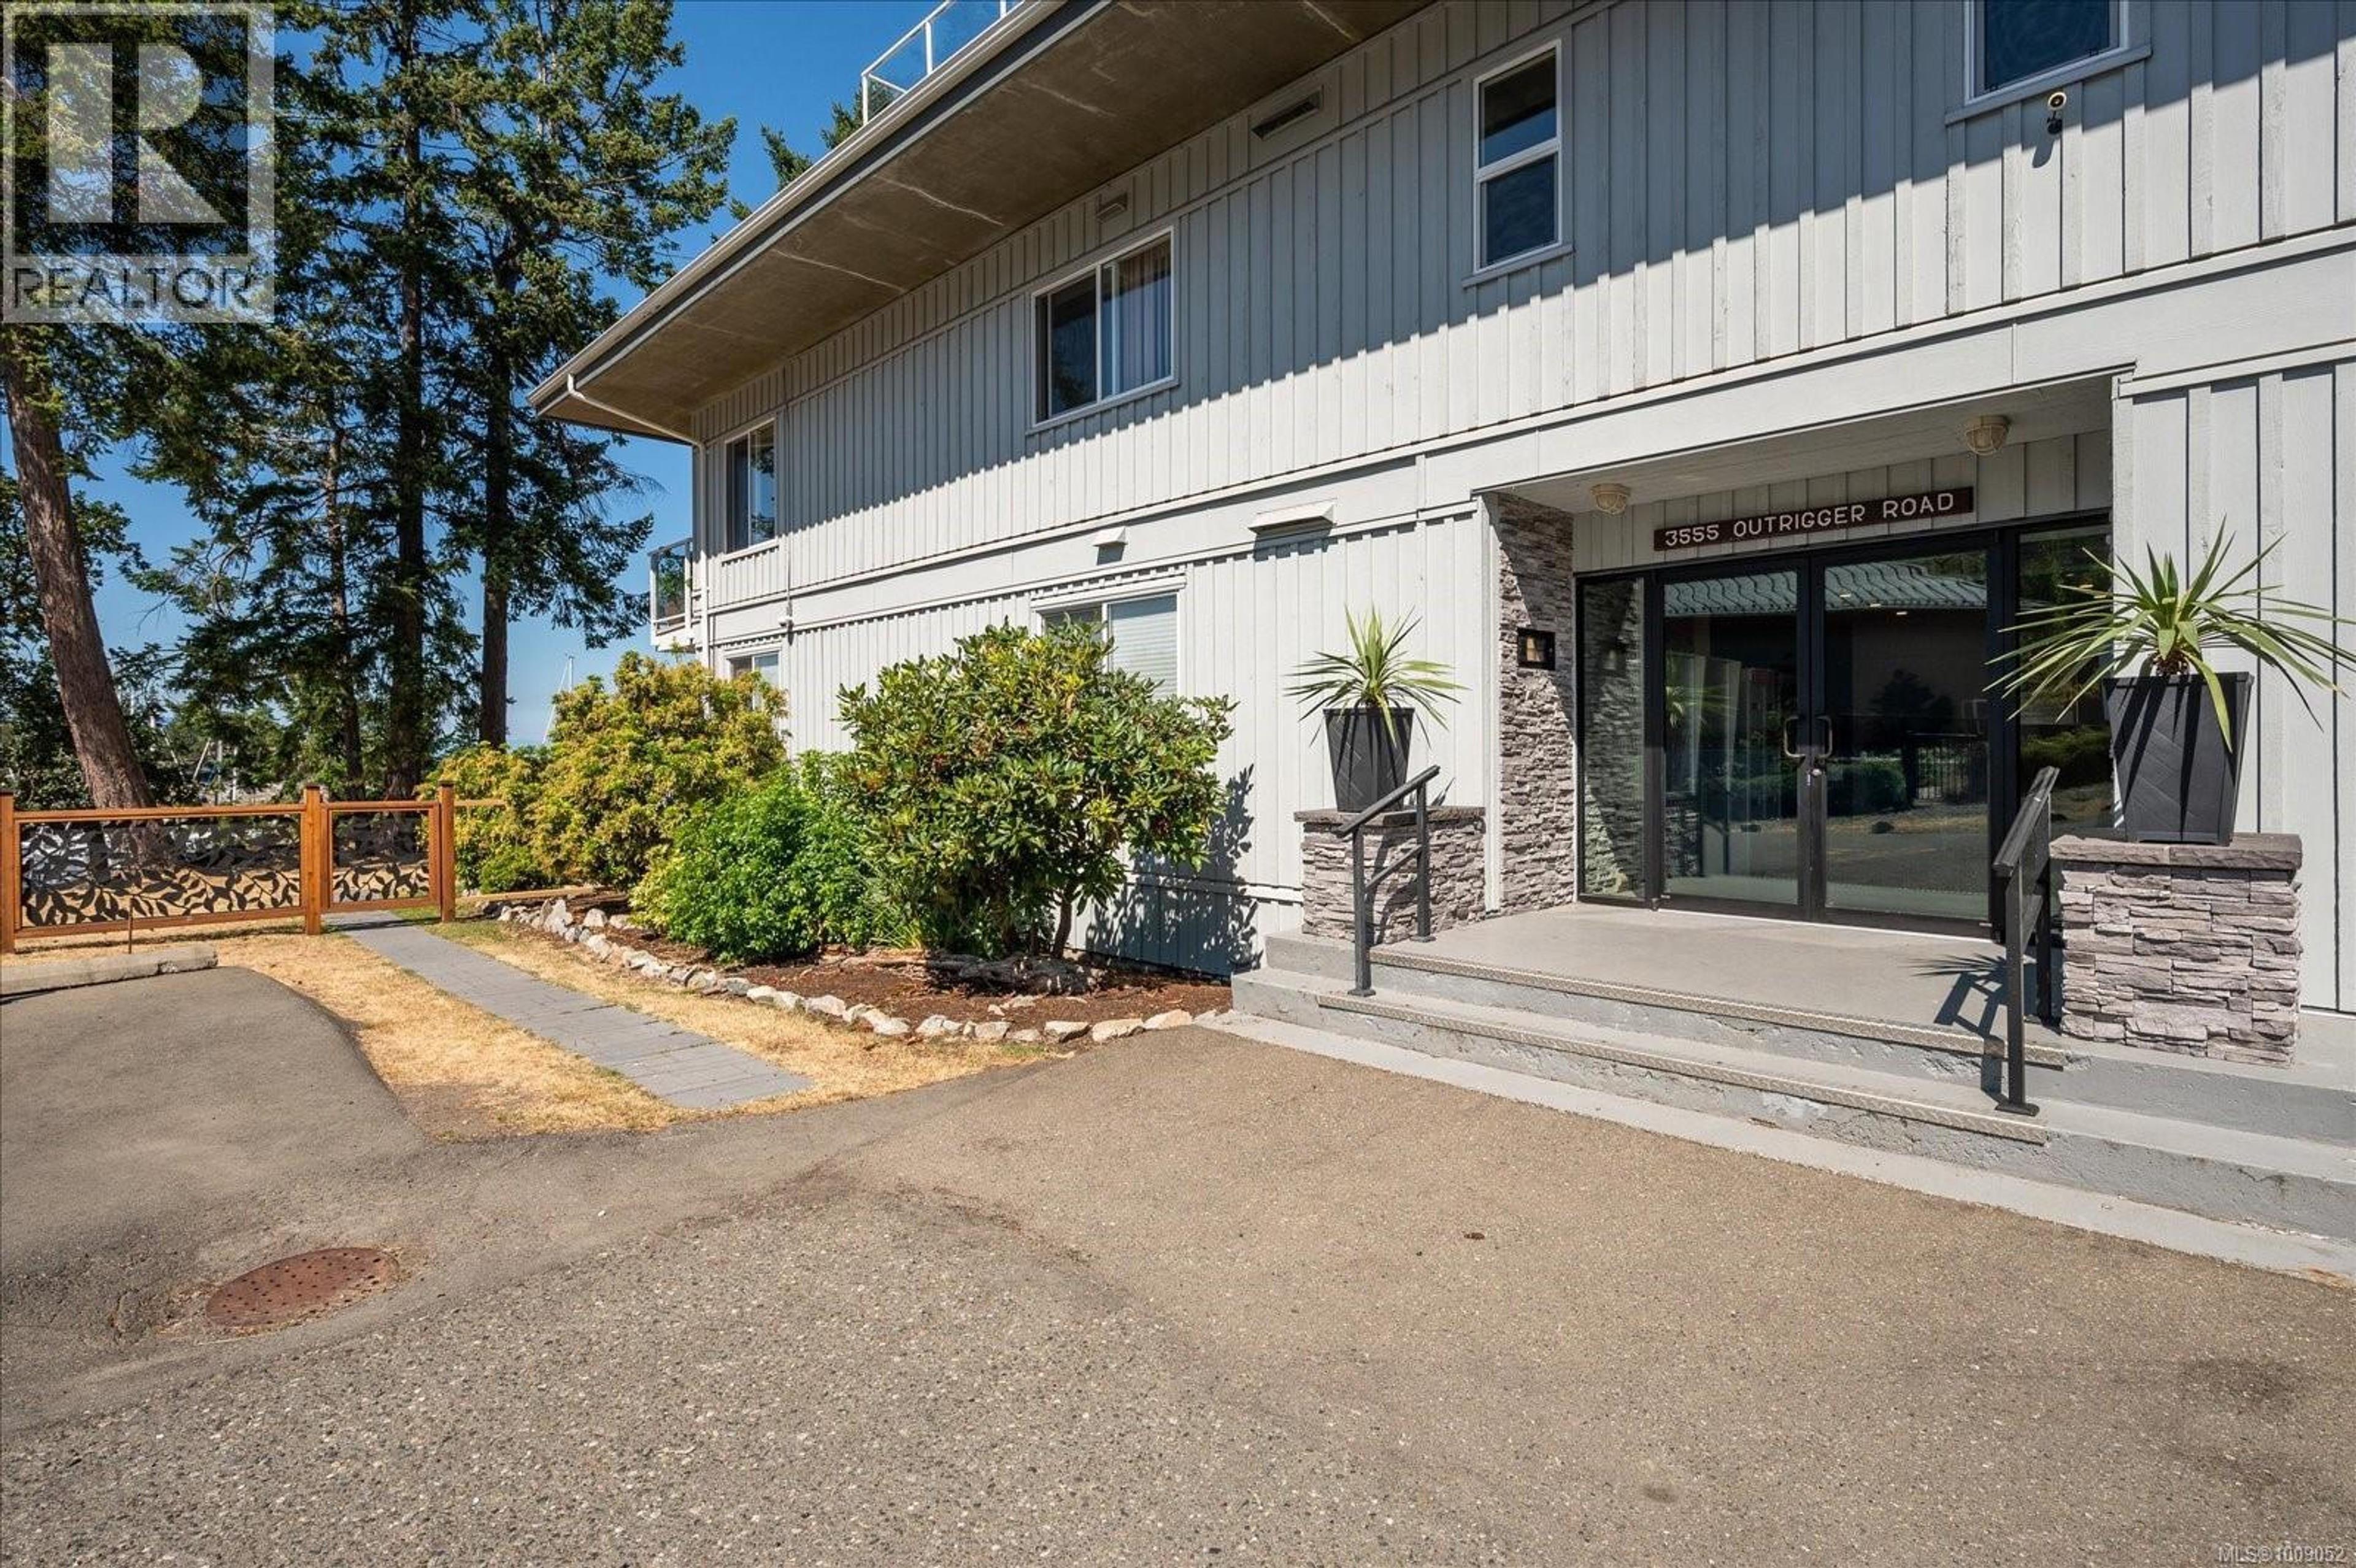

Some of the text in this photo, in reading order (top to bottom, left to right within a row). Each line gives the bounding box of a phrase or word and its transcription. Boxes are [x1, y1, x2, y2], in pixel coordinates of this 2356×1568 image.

[1665, 493, 1954, 547] 3555 OUTRIGGER ROAD
